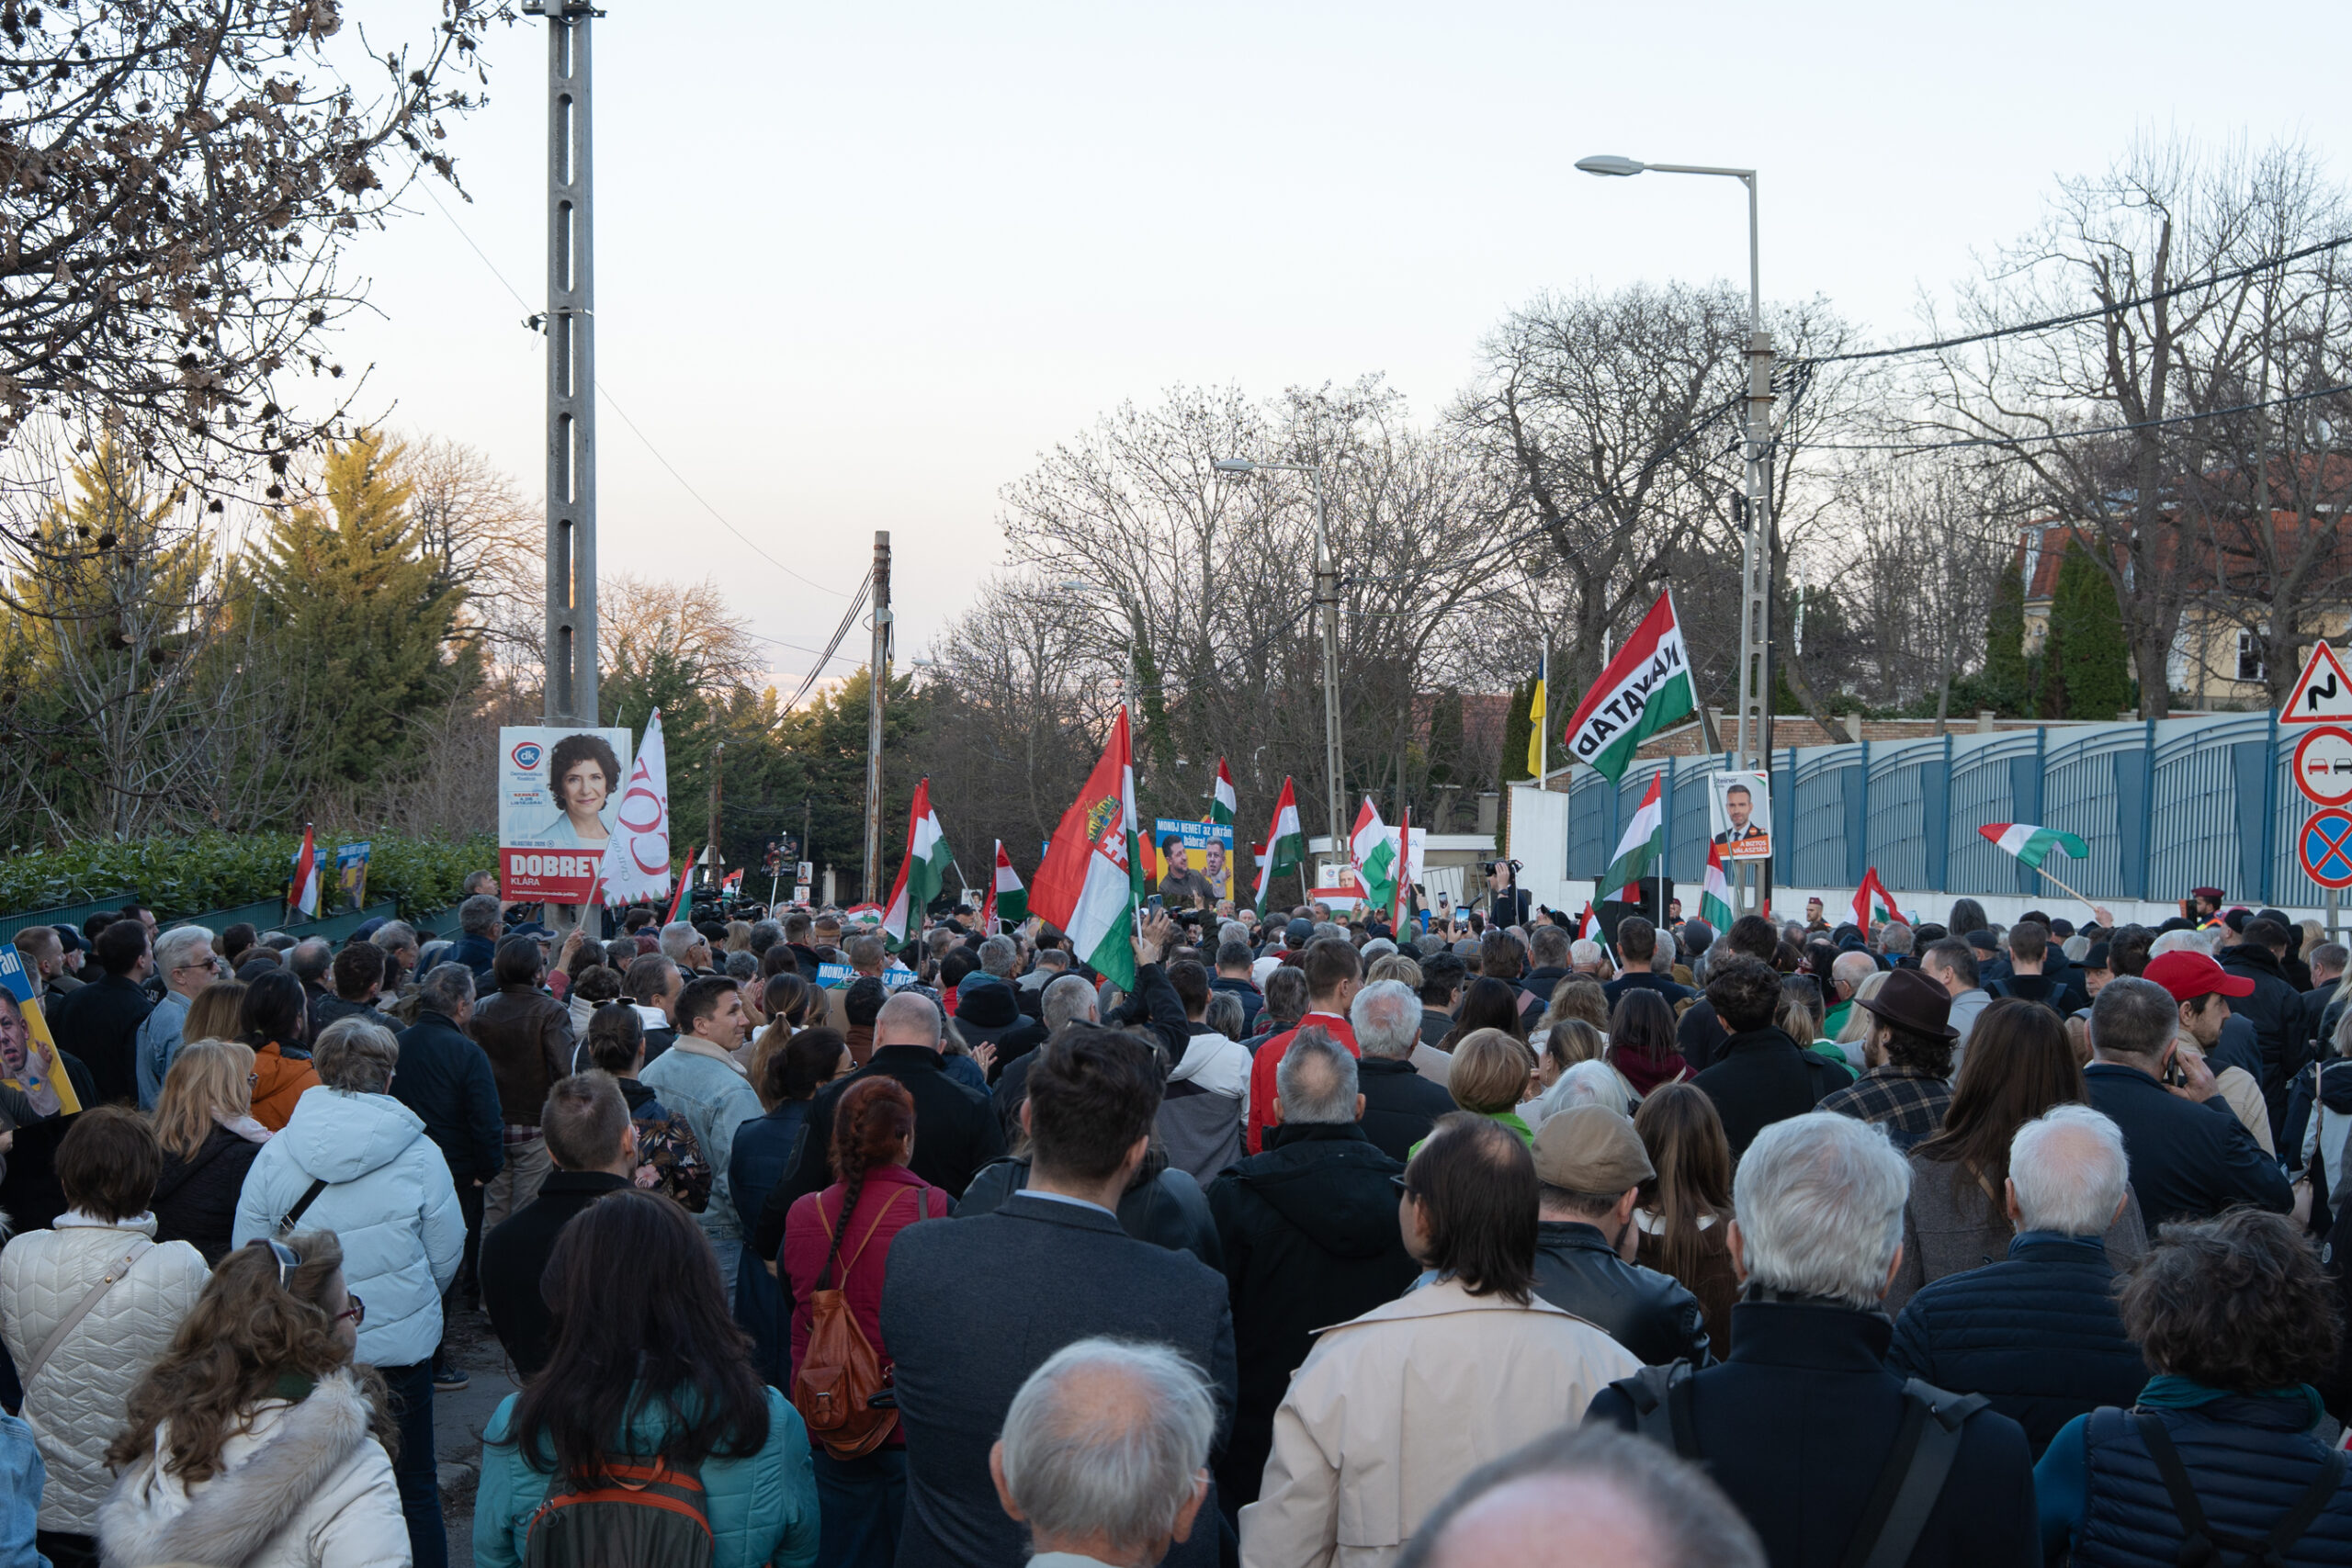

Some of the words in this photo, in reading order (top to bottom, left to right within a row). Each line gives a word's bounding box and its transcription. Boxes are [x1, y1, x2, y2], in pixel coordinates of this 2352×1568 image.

[520, 750, 536, 761] dk
[1181, 822, 1202, 835] NEMET
[1203, 826, 1211, 836] az
[1212, 826, 1232, 839] ukrán
[510, 876, 541, 886] KLÁRA
